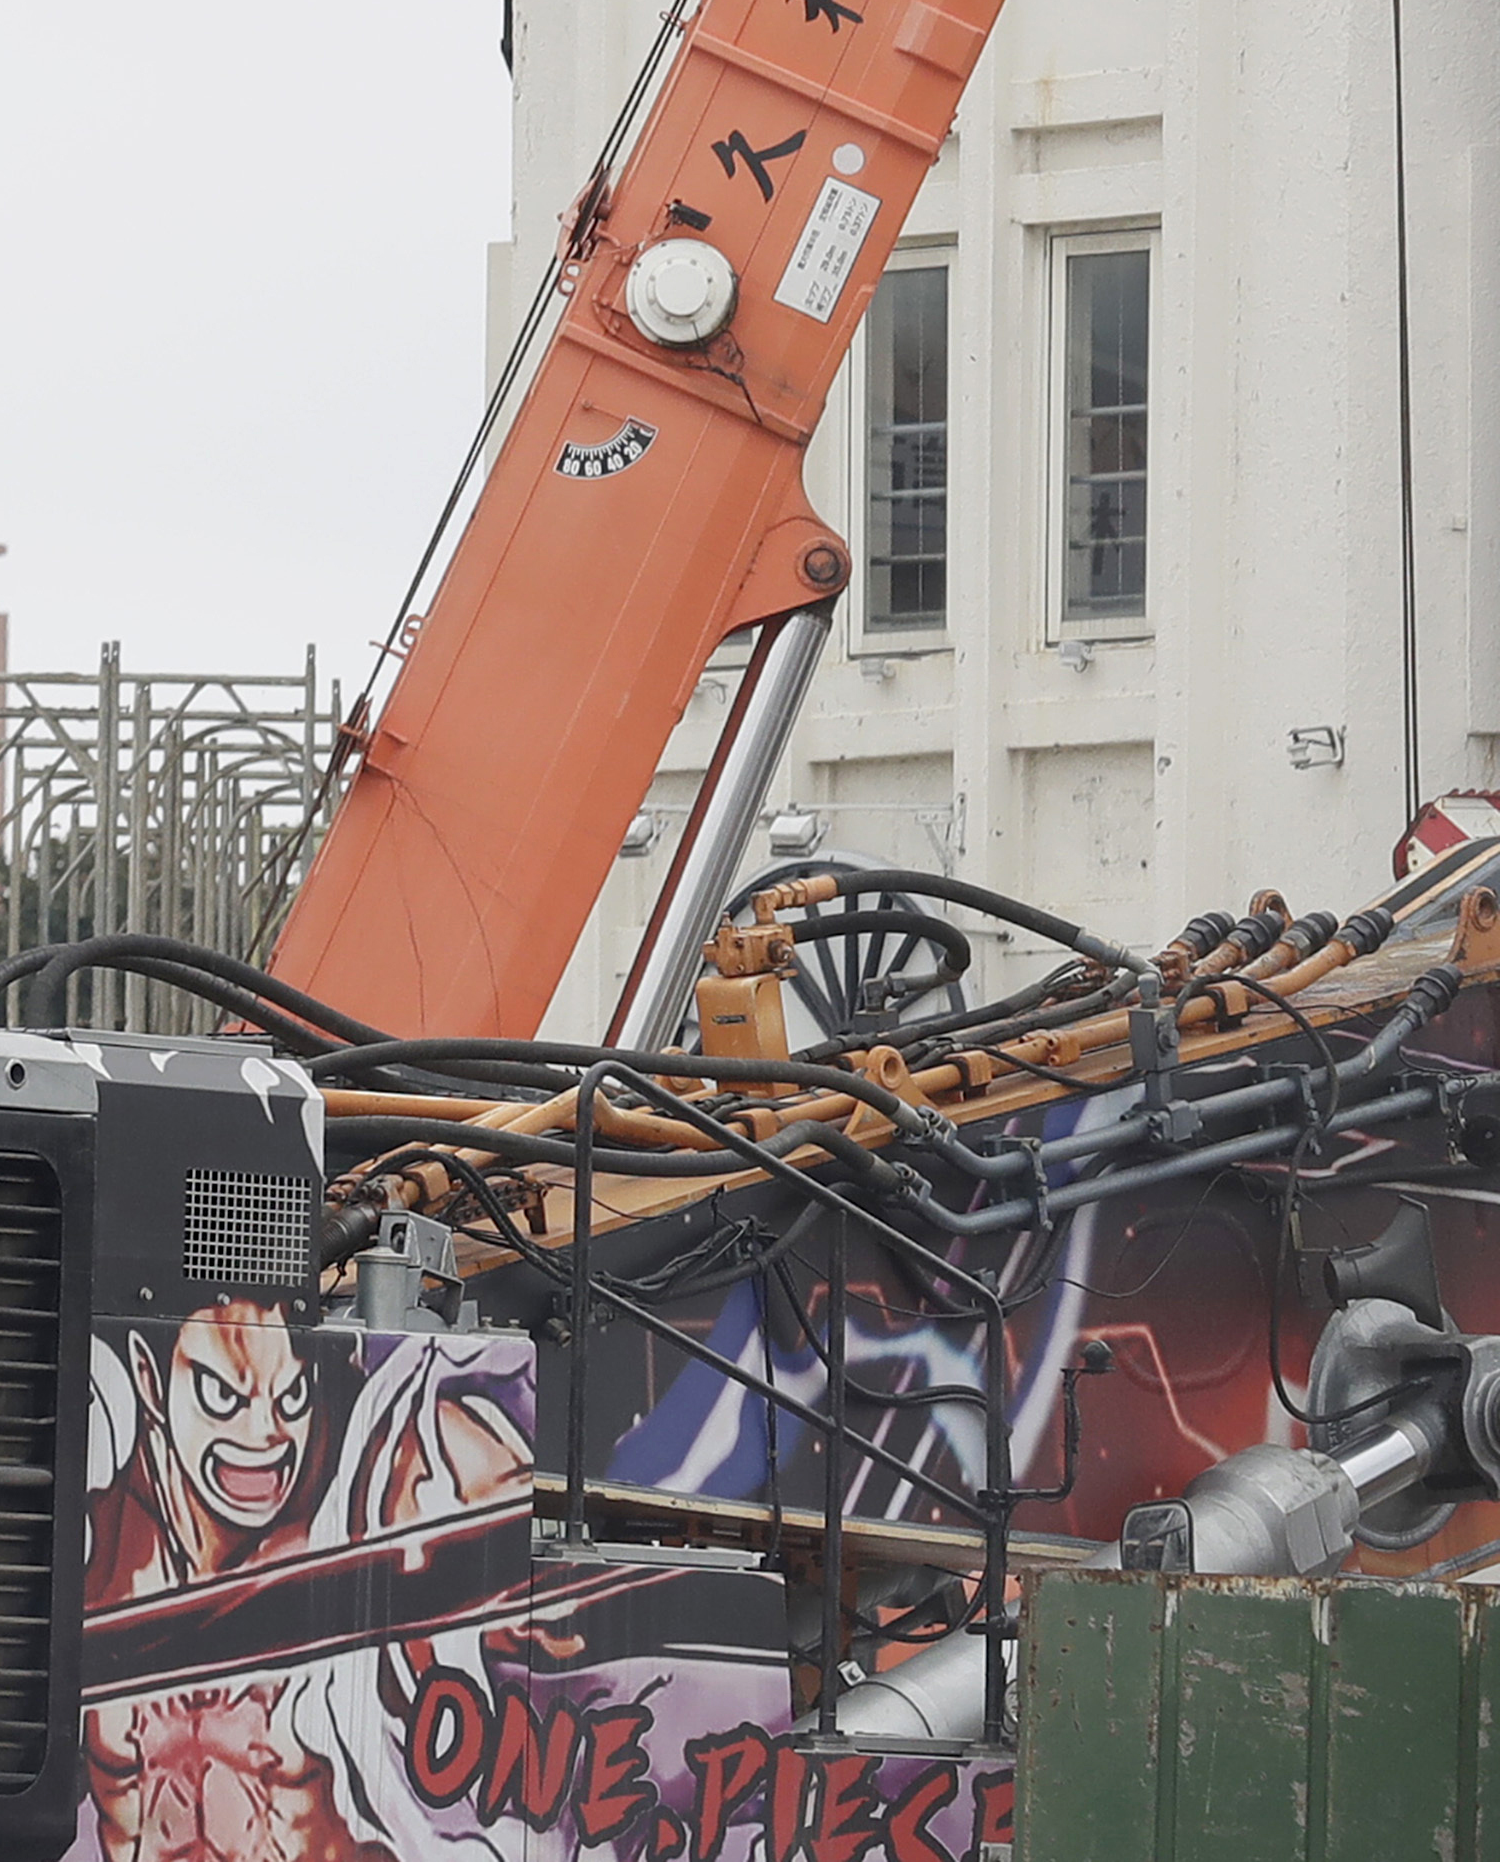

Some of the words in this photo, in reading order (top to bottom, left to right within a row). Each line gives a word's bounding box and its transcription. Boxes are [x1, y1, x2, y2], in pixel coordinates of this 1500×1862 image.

[562, 458, 580, 475] 80
[584, 460, 602, 477] 60
[607, 453, 624, 471] 40
[623, 440, 643, 460] 20
